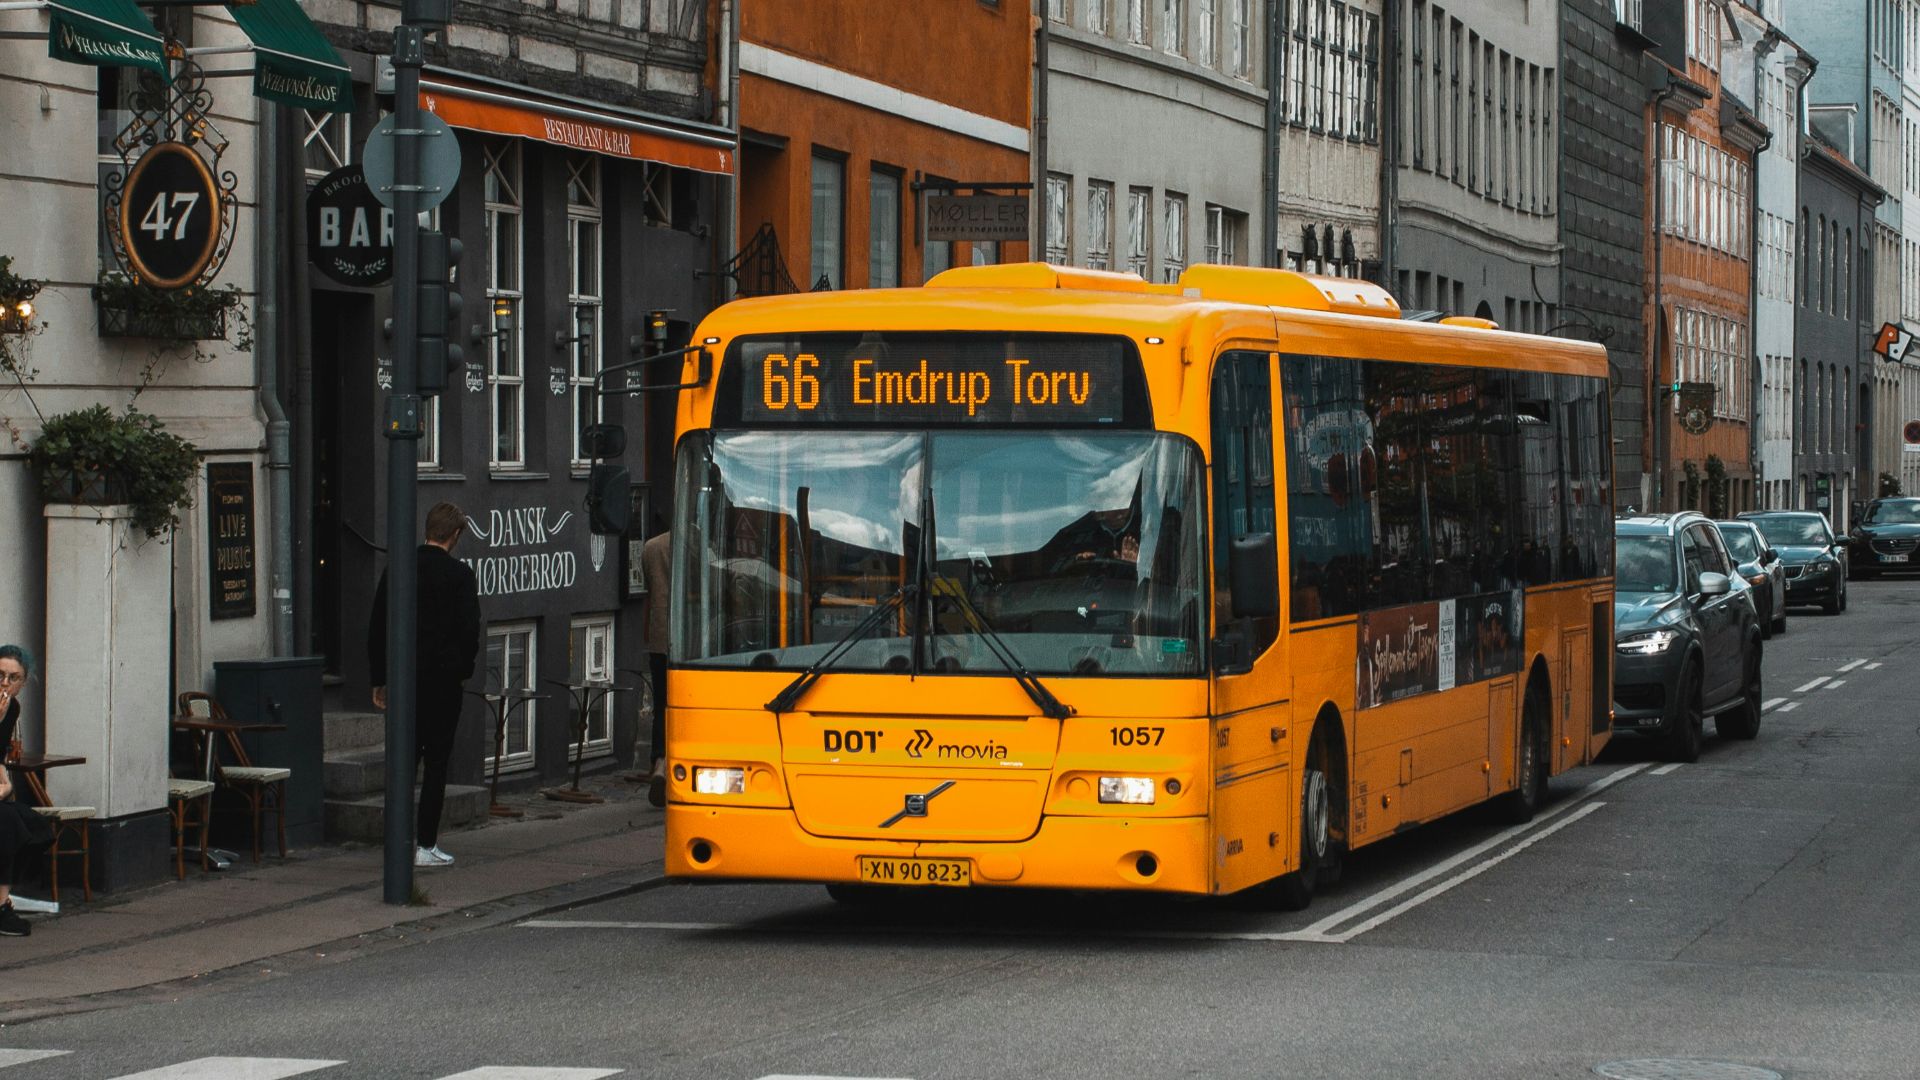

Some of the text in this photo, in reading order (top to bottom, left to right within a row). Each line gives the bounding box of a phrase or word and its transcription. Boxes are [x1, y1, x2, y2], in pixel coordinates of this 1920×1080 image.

[544, 118, 631, 156] RESTAURANT & BAR
[323, 174, 366, 197] BROO
[140, 192, 199, 241] 47
[928, 204, 1026, 221] MØLLER
[320, 206, 394, 247] BAR
[763, 354, 1090, 416] 66 Emdrup Torv
[220, 513, 246, 538] LIVE
[489, 507, 548, 548] DANSK
[217, 545, 251, 571] MUSIC
[824, 729, 1008, 760] DOT movia
[1110, 726, 1165, 747] 1057
[1216, 727, 1230, 749] 1057
[870, 861, 961, 882] XN 90 823
